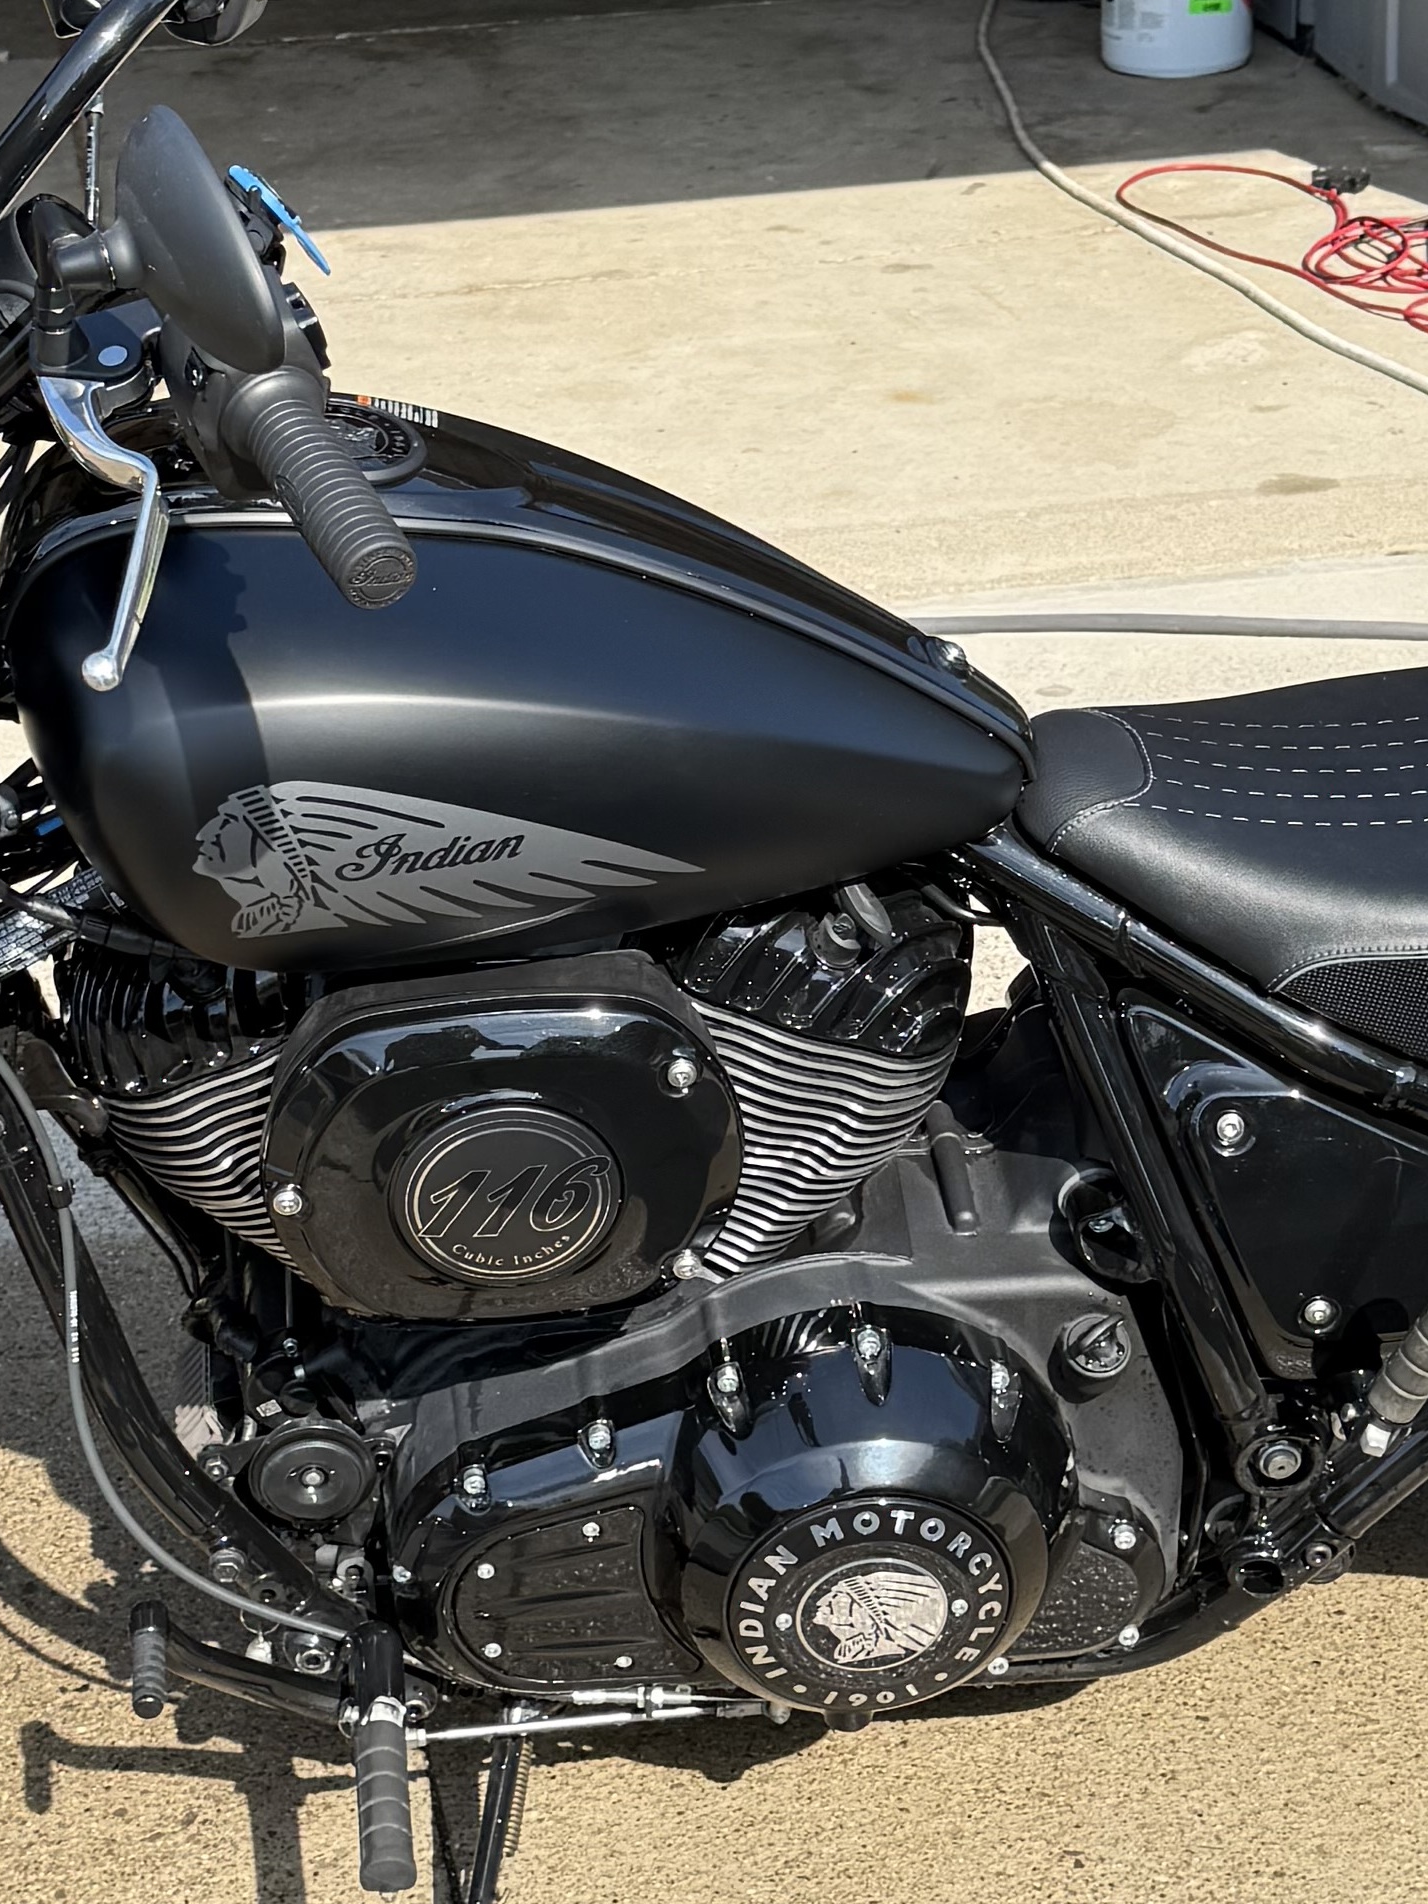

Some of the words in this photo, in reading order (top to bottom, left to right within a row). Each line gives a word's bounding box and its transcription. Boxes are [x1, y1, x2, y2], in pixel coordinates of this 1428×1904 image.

[335, 832, 525, 882] Indian
[418, 1156, 611, 1238] 116
[452, 1243, 504, 1269] Cubic
[513, 1234, 571, 1266] Inches
[739, 1544, 799, 1679] INDIAN
[810, 1509, 1002, 1663] MOTORCYCLE
[824, 1683, 920, 1706] 1901
